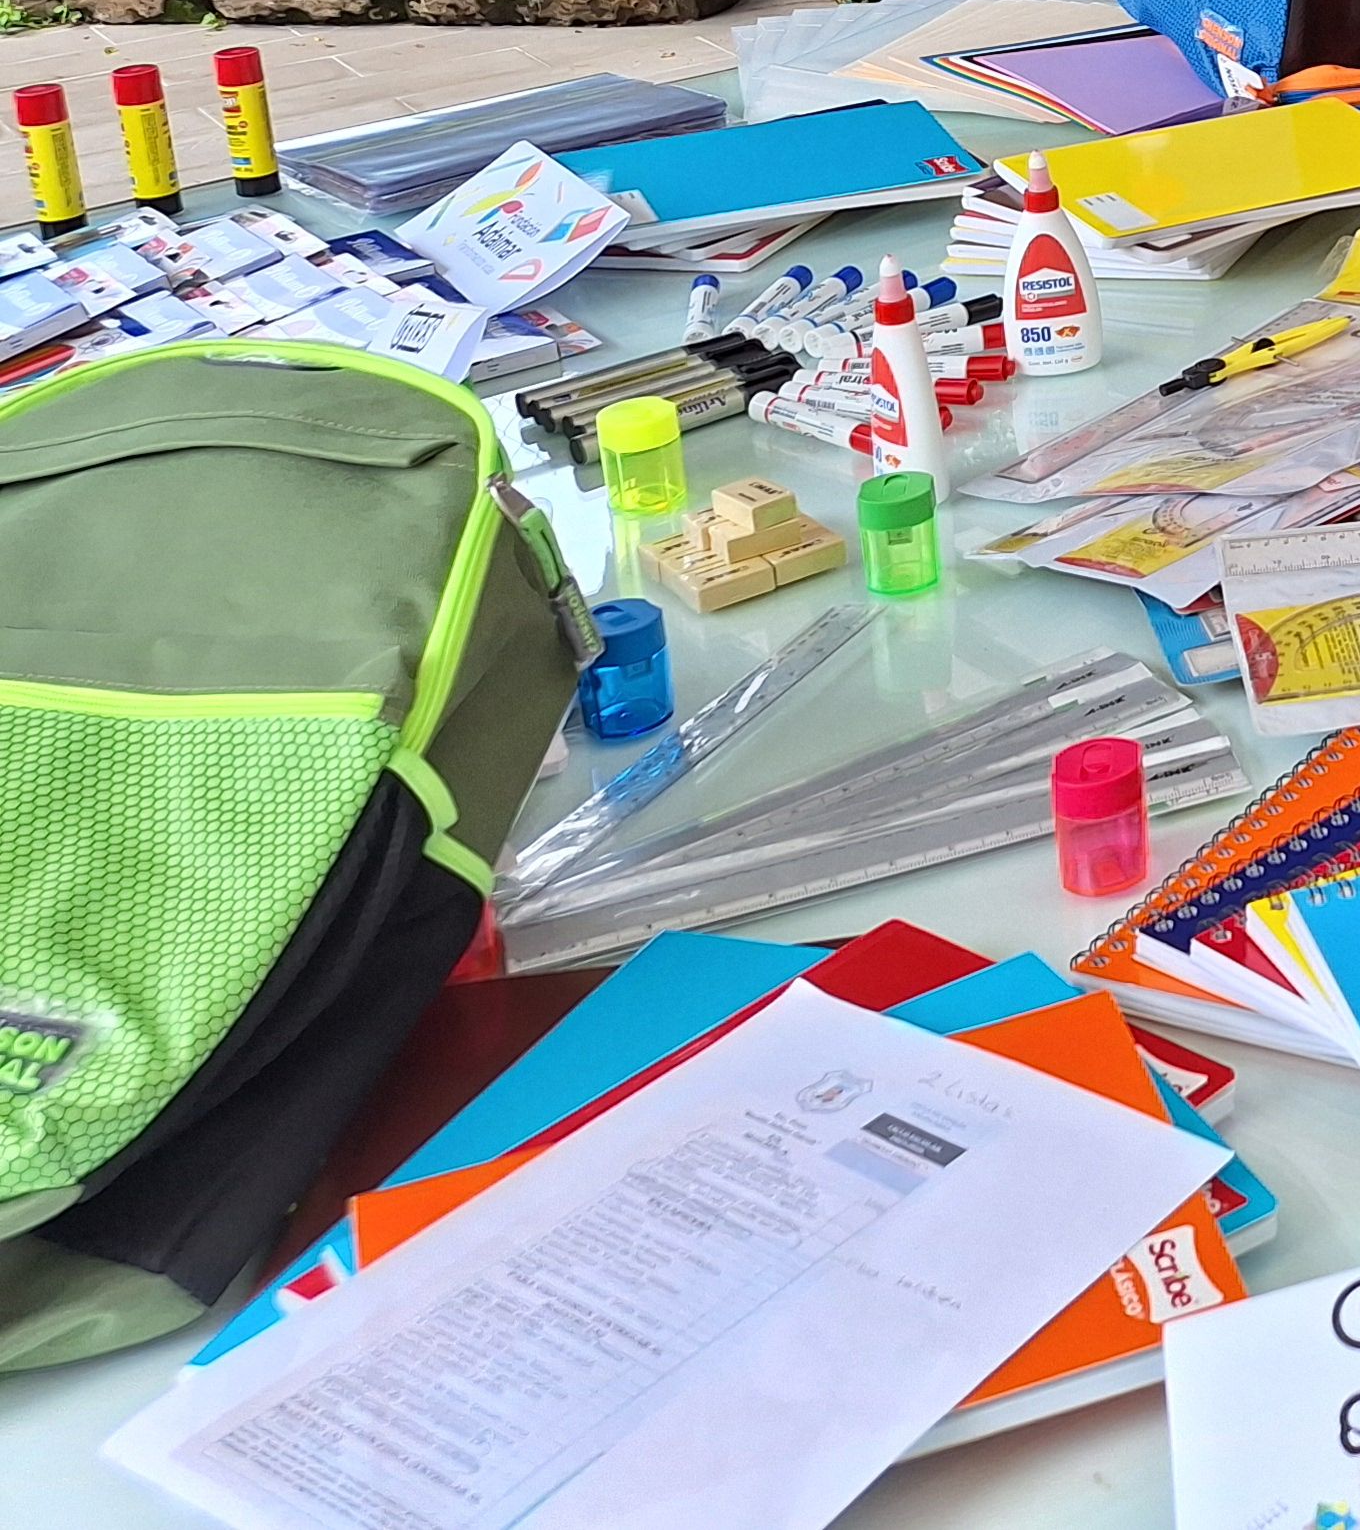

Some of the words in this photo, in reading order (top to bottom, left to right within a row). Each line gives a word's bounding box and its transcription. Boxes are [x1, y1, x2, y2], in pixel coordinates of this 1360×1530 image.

[1022, 276, 1073, 291] RESISTOL
[1020, 326, 1052, 343] 850
[1148, 1238, 1192, 1309] Scribe
